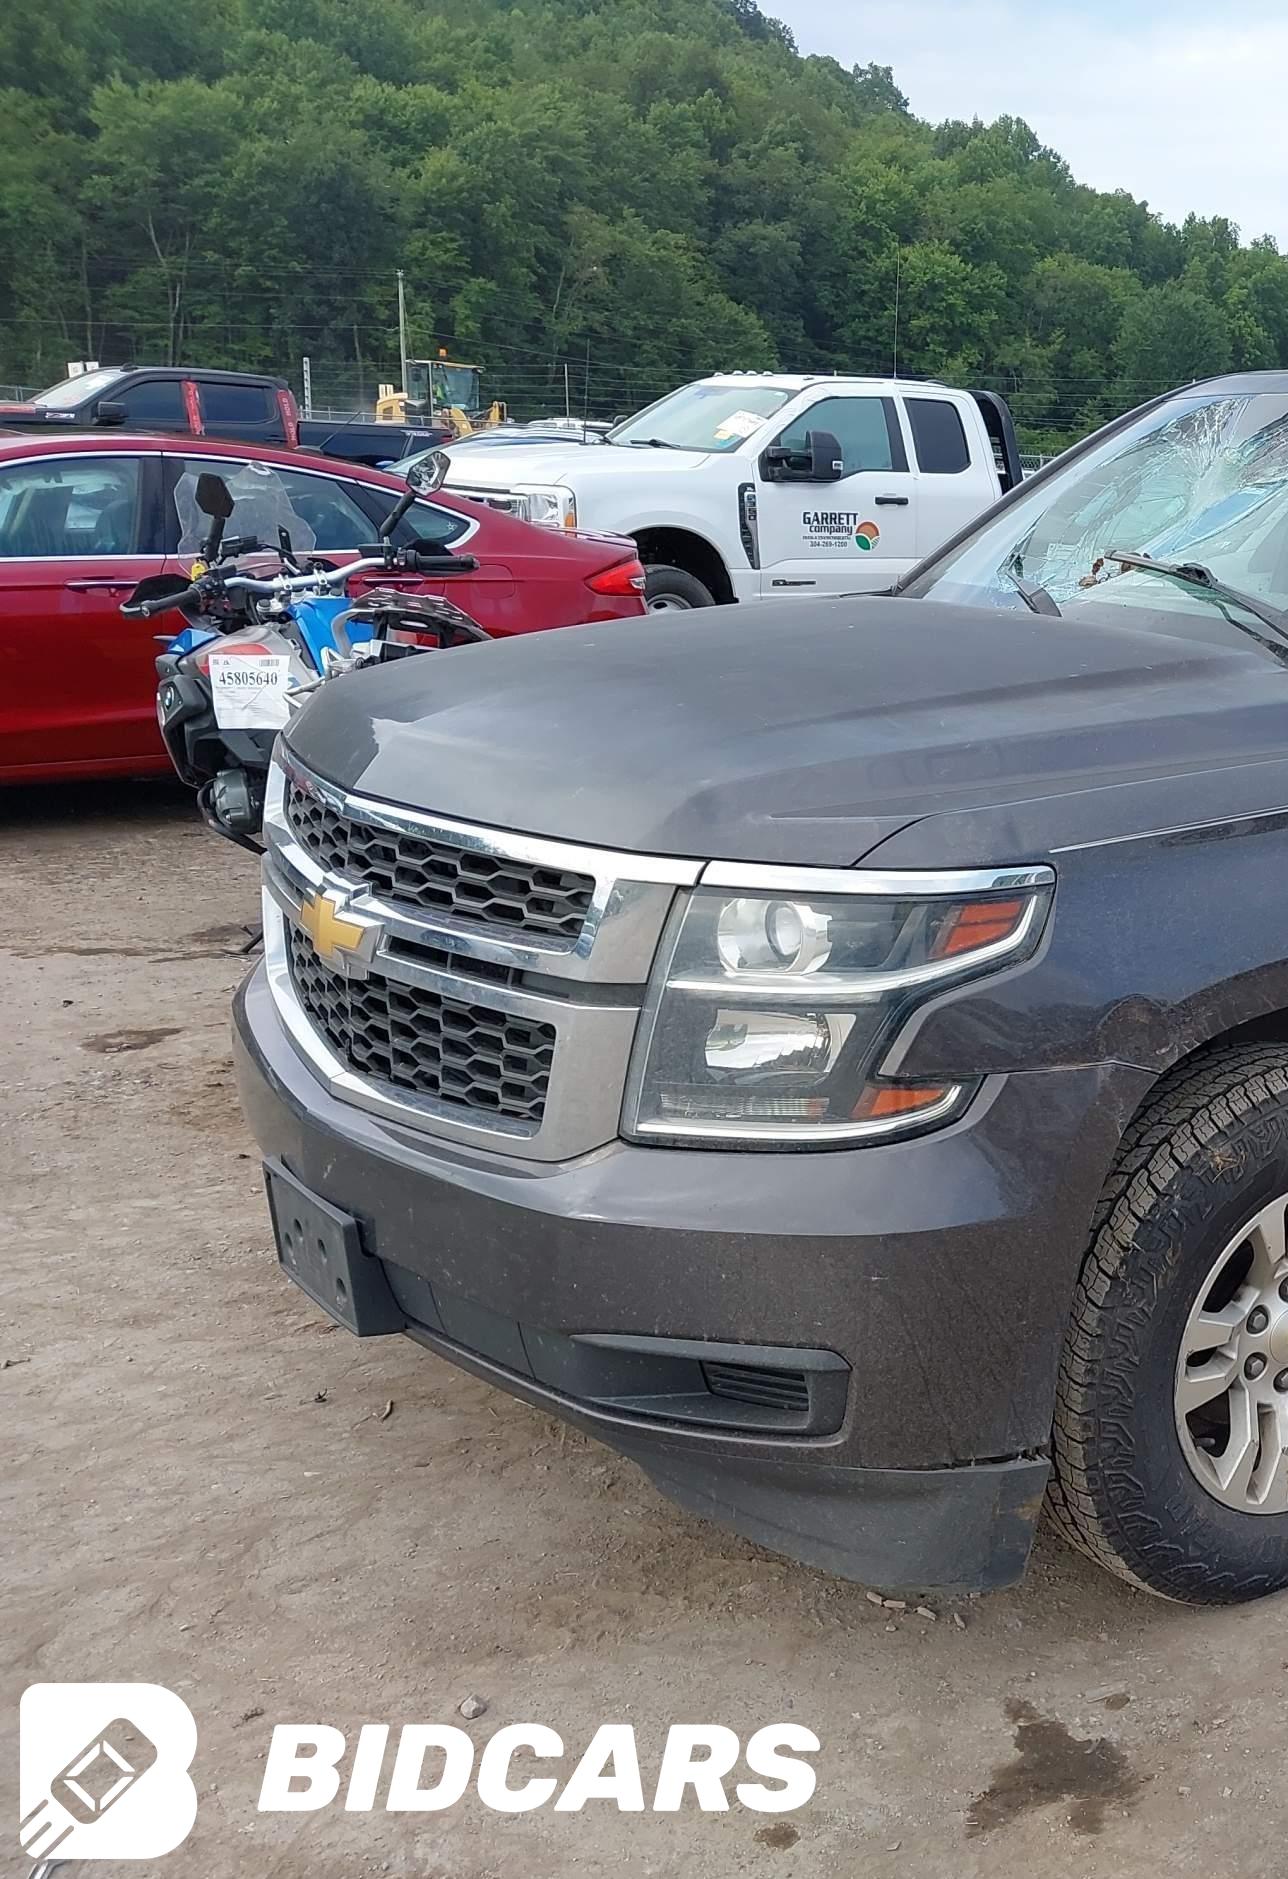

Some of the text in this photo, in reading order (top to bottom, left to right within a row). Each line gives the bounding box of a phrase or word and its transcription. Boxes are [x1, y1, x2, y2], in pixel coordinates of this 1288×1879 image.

[802, 511, 858, 525] GARRETT
[809, 524, 853, 535] company
[219, 671, 278, 686] 45805640
